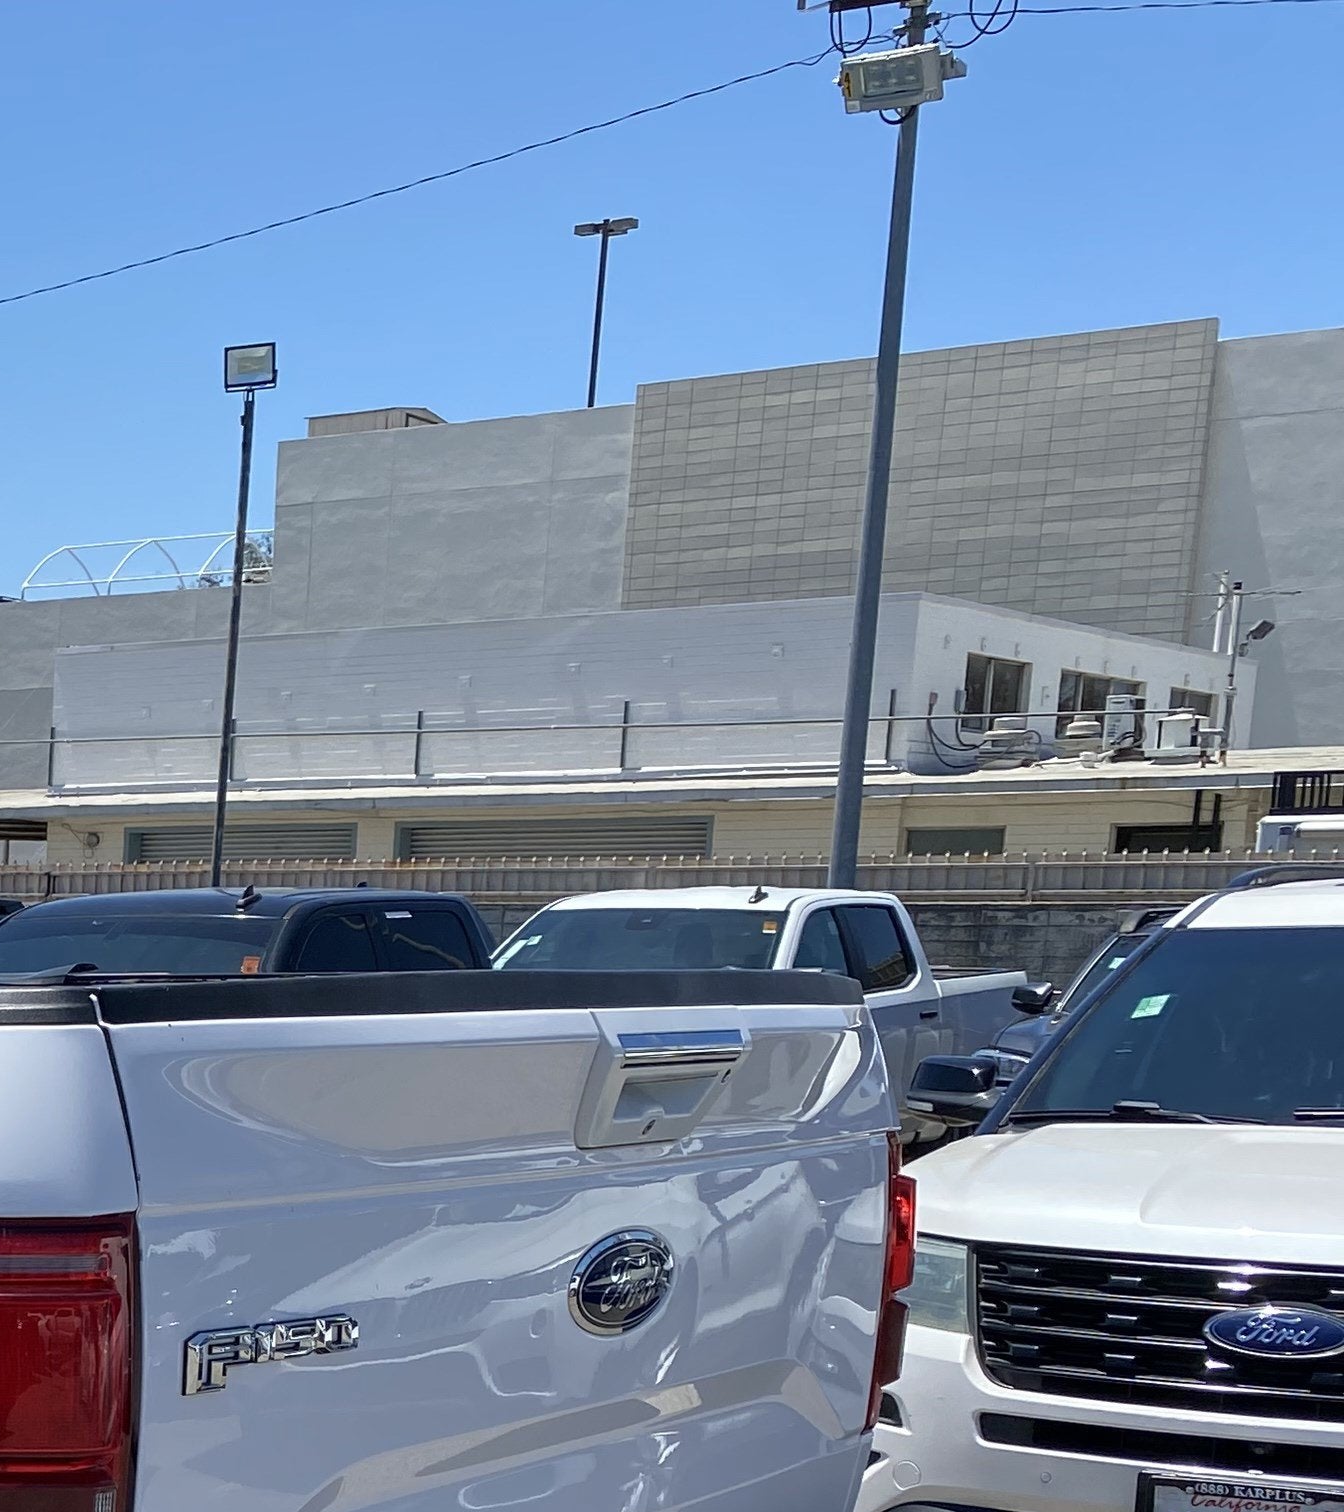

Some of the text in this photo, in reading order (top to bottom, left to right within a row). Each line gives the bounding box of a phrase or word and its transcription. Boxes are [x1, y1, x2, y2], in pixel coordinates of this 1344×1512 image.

[1235, 1314, 1321, 1347] Ford
[1194, 1483, 1306, 1503] (888) KARPLUS
